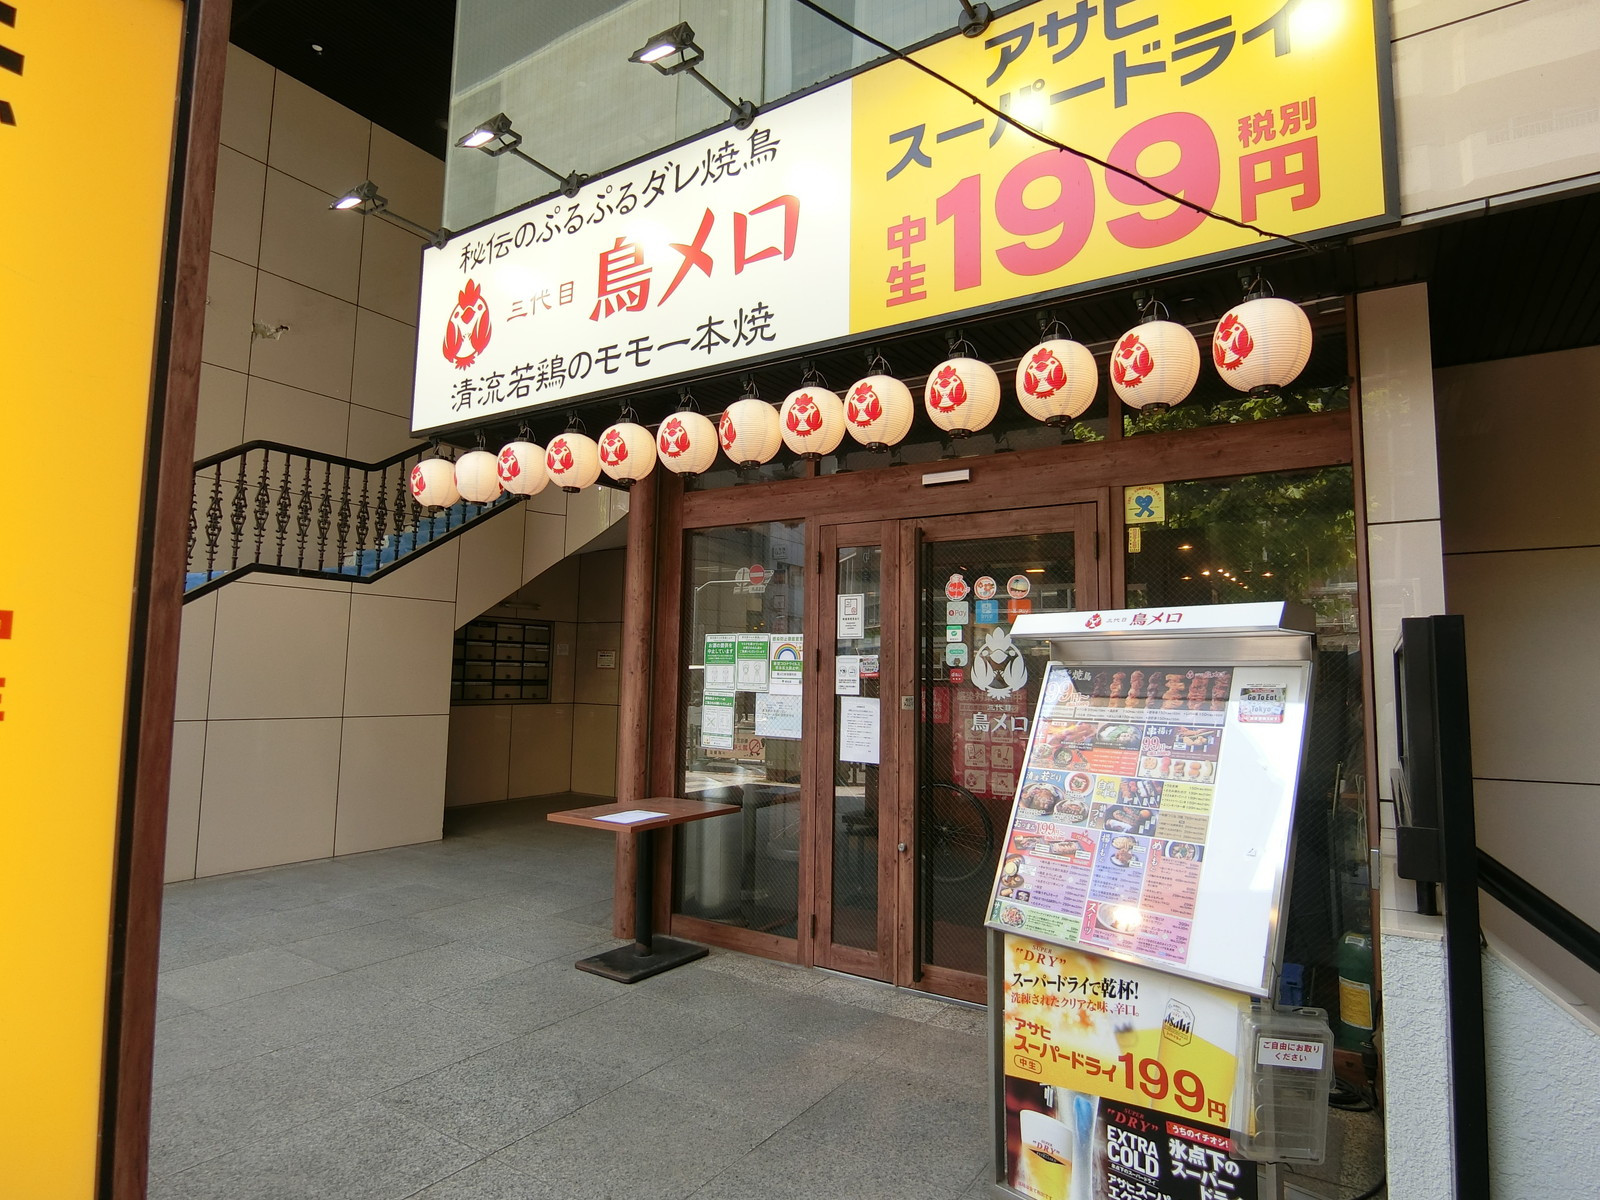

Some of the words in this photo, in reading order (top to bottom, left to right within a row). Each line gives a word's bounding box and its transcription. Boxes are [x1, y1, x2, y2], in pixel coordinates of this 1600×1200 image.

[985, 0, 1159, 87] アサヒ
[1238, 97, 1317, 148] 税別
[459, 128, 780, 274] 秘伝のぷるぷるダレ焼鳥
[589, 195, 801, 322] 鳥メロ
[886, 215, 927, 308] 中生
[451, 302, 776, 412] 清流若鶏のモモ一本焼
[1130, 612, 1183, 626] 鳥メロ
[971, 712, 1028, 732] 鳥メロ
[1032, 945, 1052, 954] SUPER
[1014, 1017, 1051, 1041] アサヒ
[1014, 1033, 1117, 1083] スーパードライ
[1019, 1058, 1036, 1070] 中生
[1263, 1041, 1320, 1054] ご自由にお取り
[1275, 1052, 1307, 1062] ください
[1107, 1124, 1159, 1159] EXTRA
[1172, 1124, 1229, 1149] うちのイチオシ!
[1107, 1141, 1159, 1177] COLD
[1168, 1137, 1240, 1177] 氷点下の
[1171, 1159, 1235, 1189] スーパー
